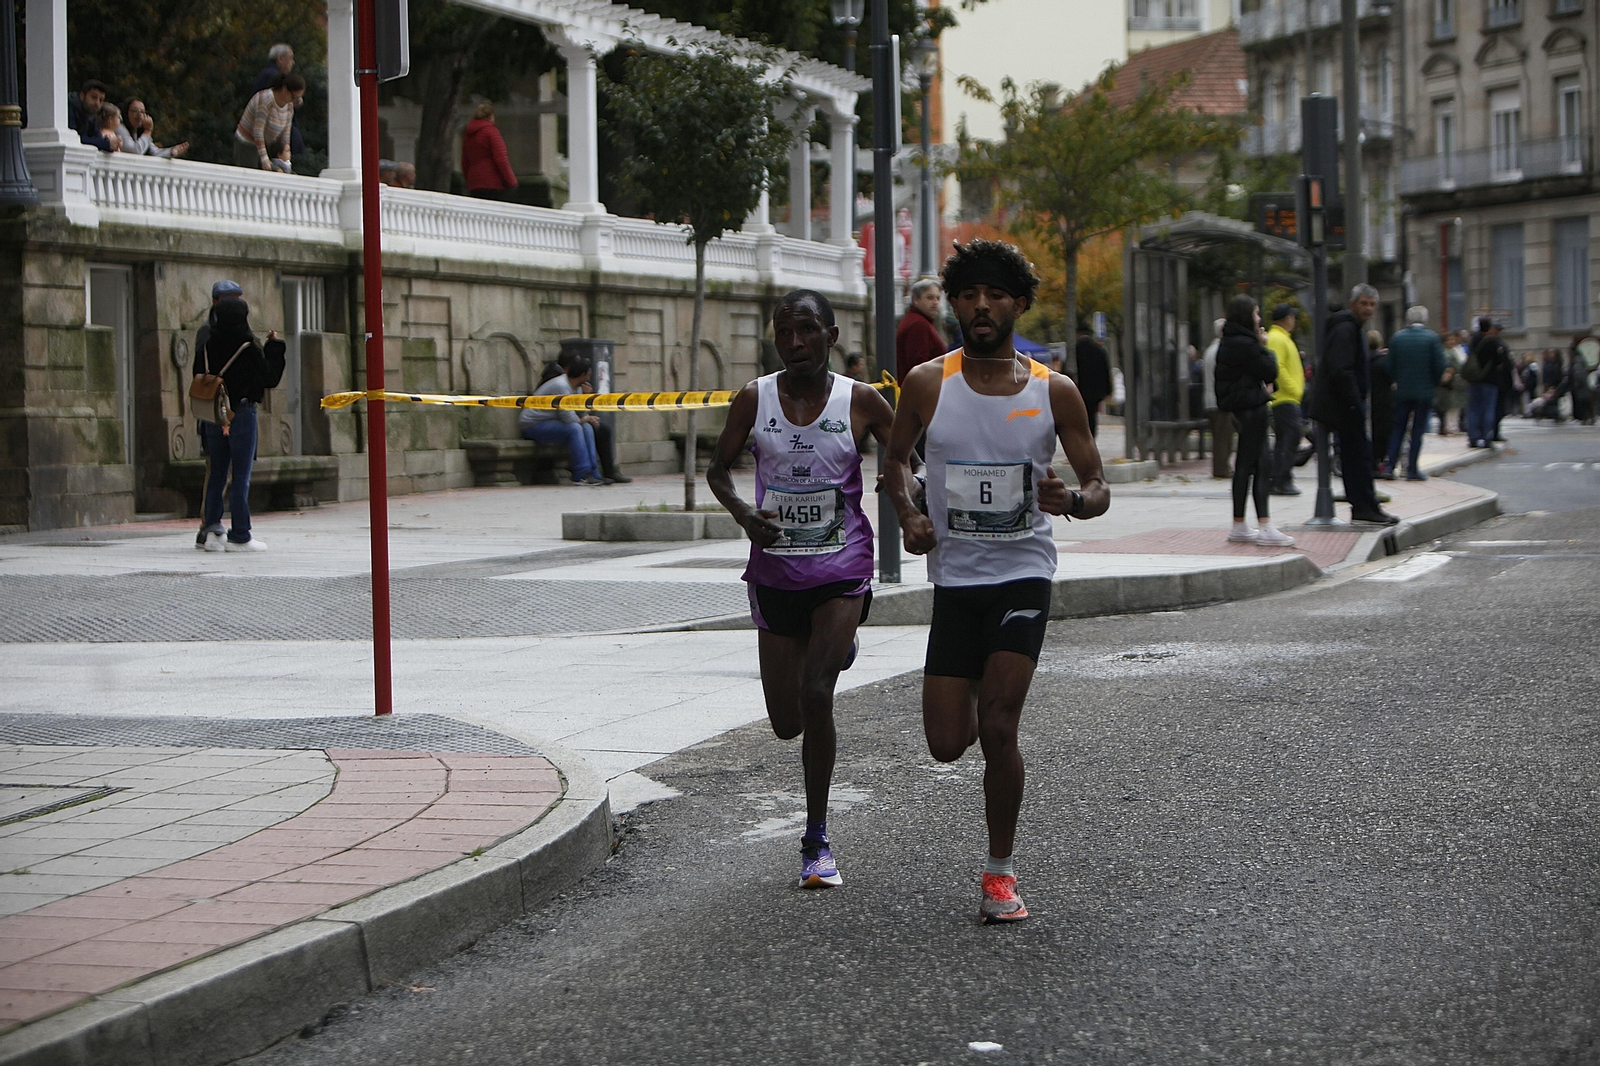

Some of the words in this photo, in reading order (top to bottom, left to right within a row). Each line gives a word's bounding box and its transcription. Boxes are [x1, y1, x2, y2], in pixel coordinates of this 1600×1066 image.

[963, 468, 1007, 477] MOHAMED
[771, 493, 793, 502] PETER
[795, 494, 826, 503] KARIUKI
[980, 481, 992, 505] 6
[778, 504, 822, 524] 1459
